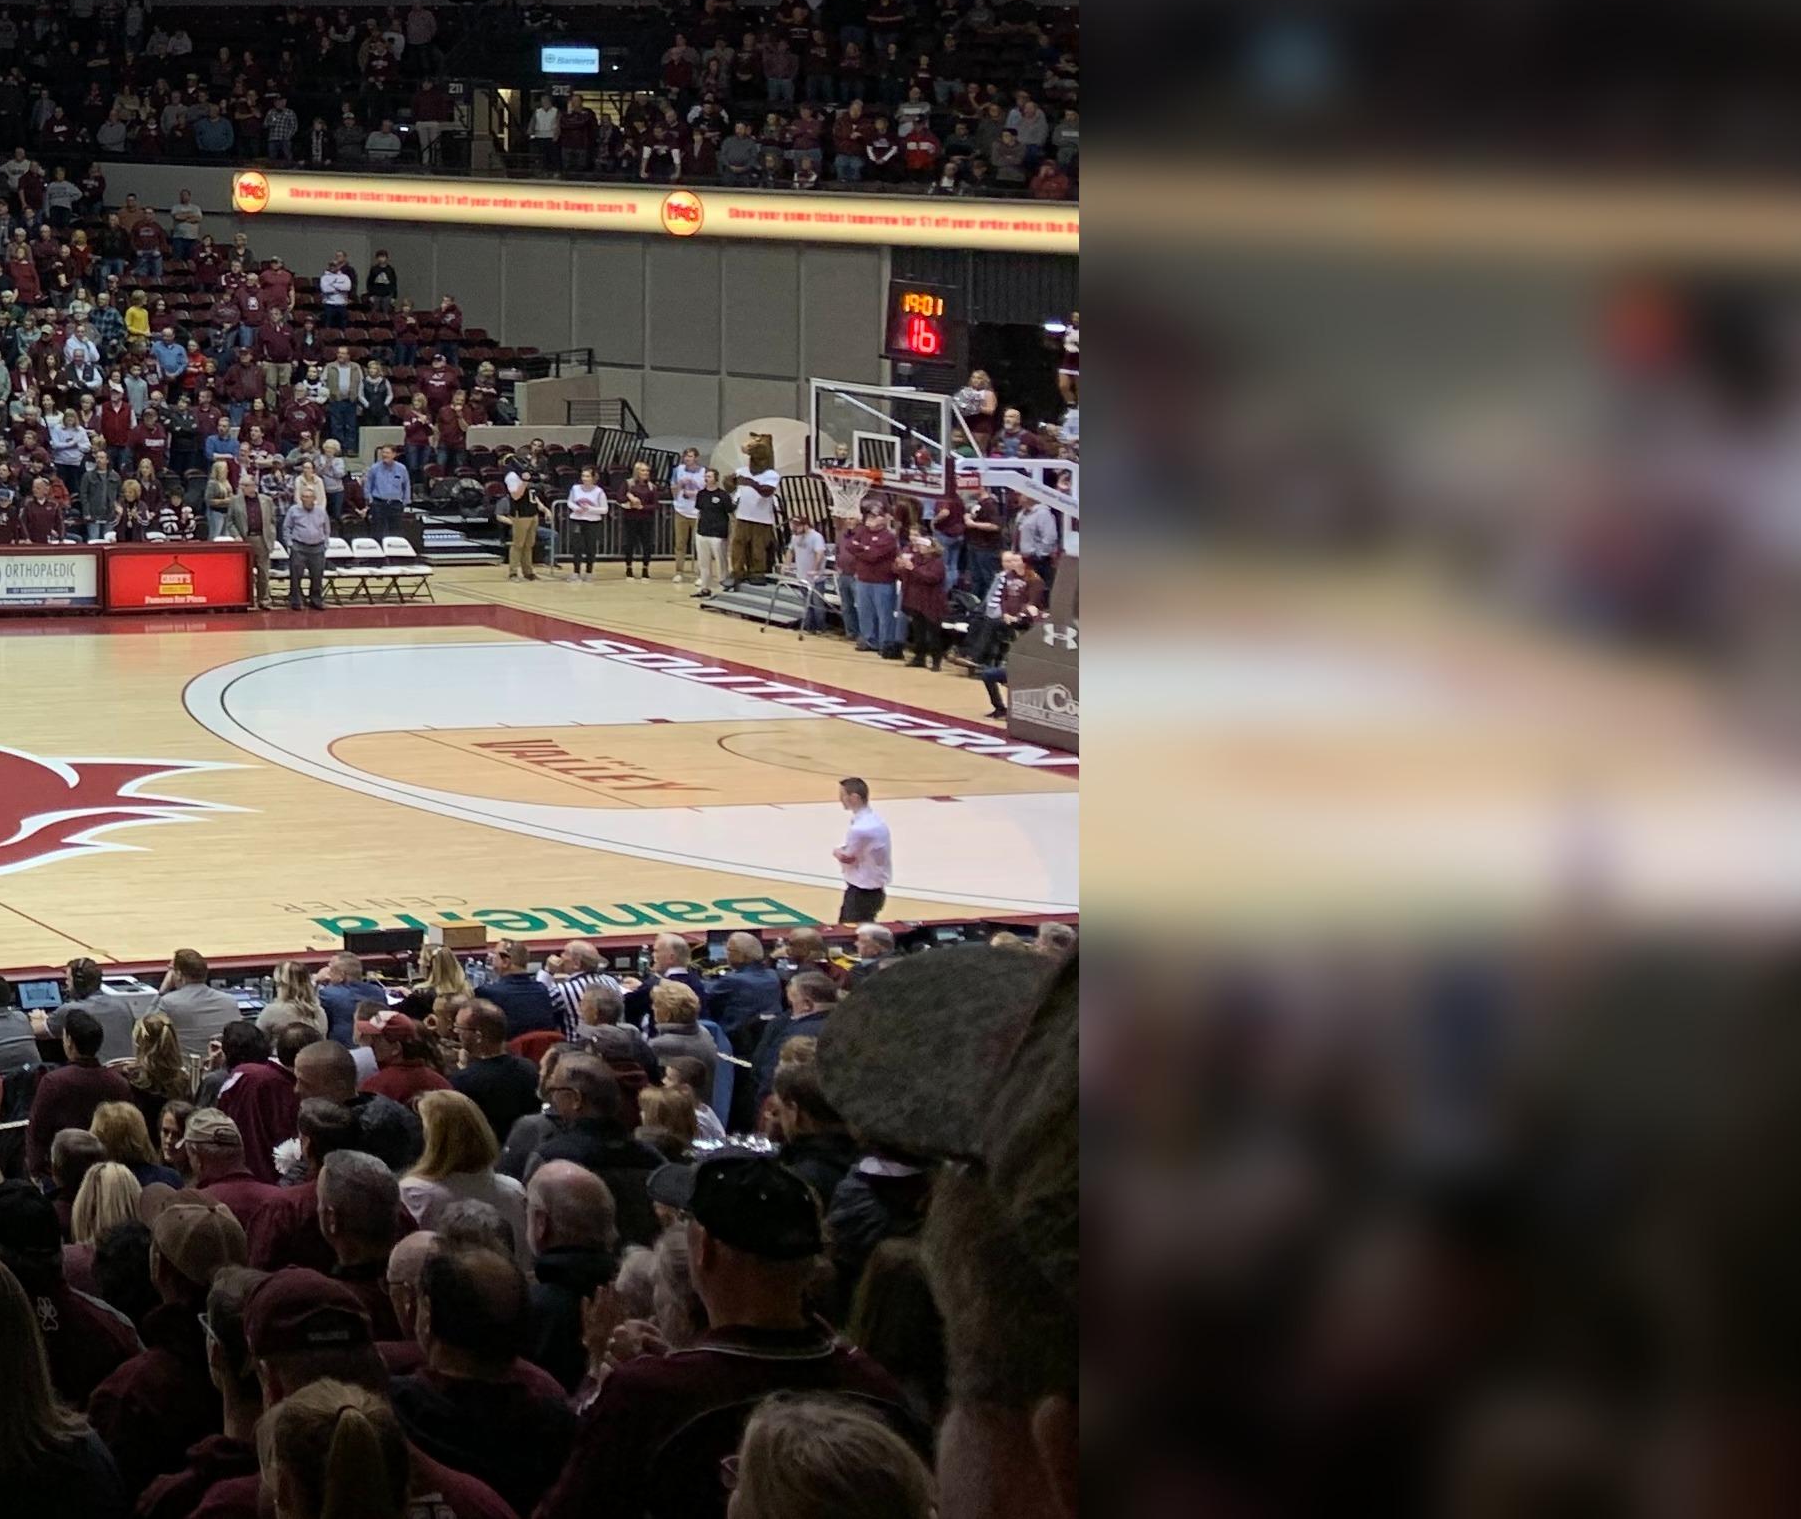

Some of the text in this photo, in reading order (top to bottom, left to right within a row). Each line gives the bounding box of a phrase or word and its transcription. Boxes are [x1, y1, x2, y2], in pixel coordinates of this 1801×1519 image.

[904, 293, 943, 316] 19:01
[911, 317, 935, 353] 16
[5, 562, 76, 577] ORTHOPAEDIC
[471, 740, 719, 791] VALLEY
